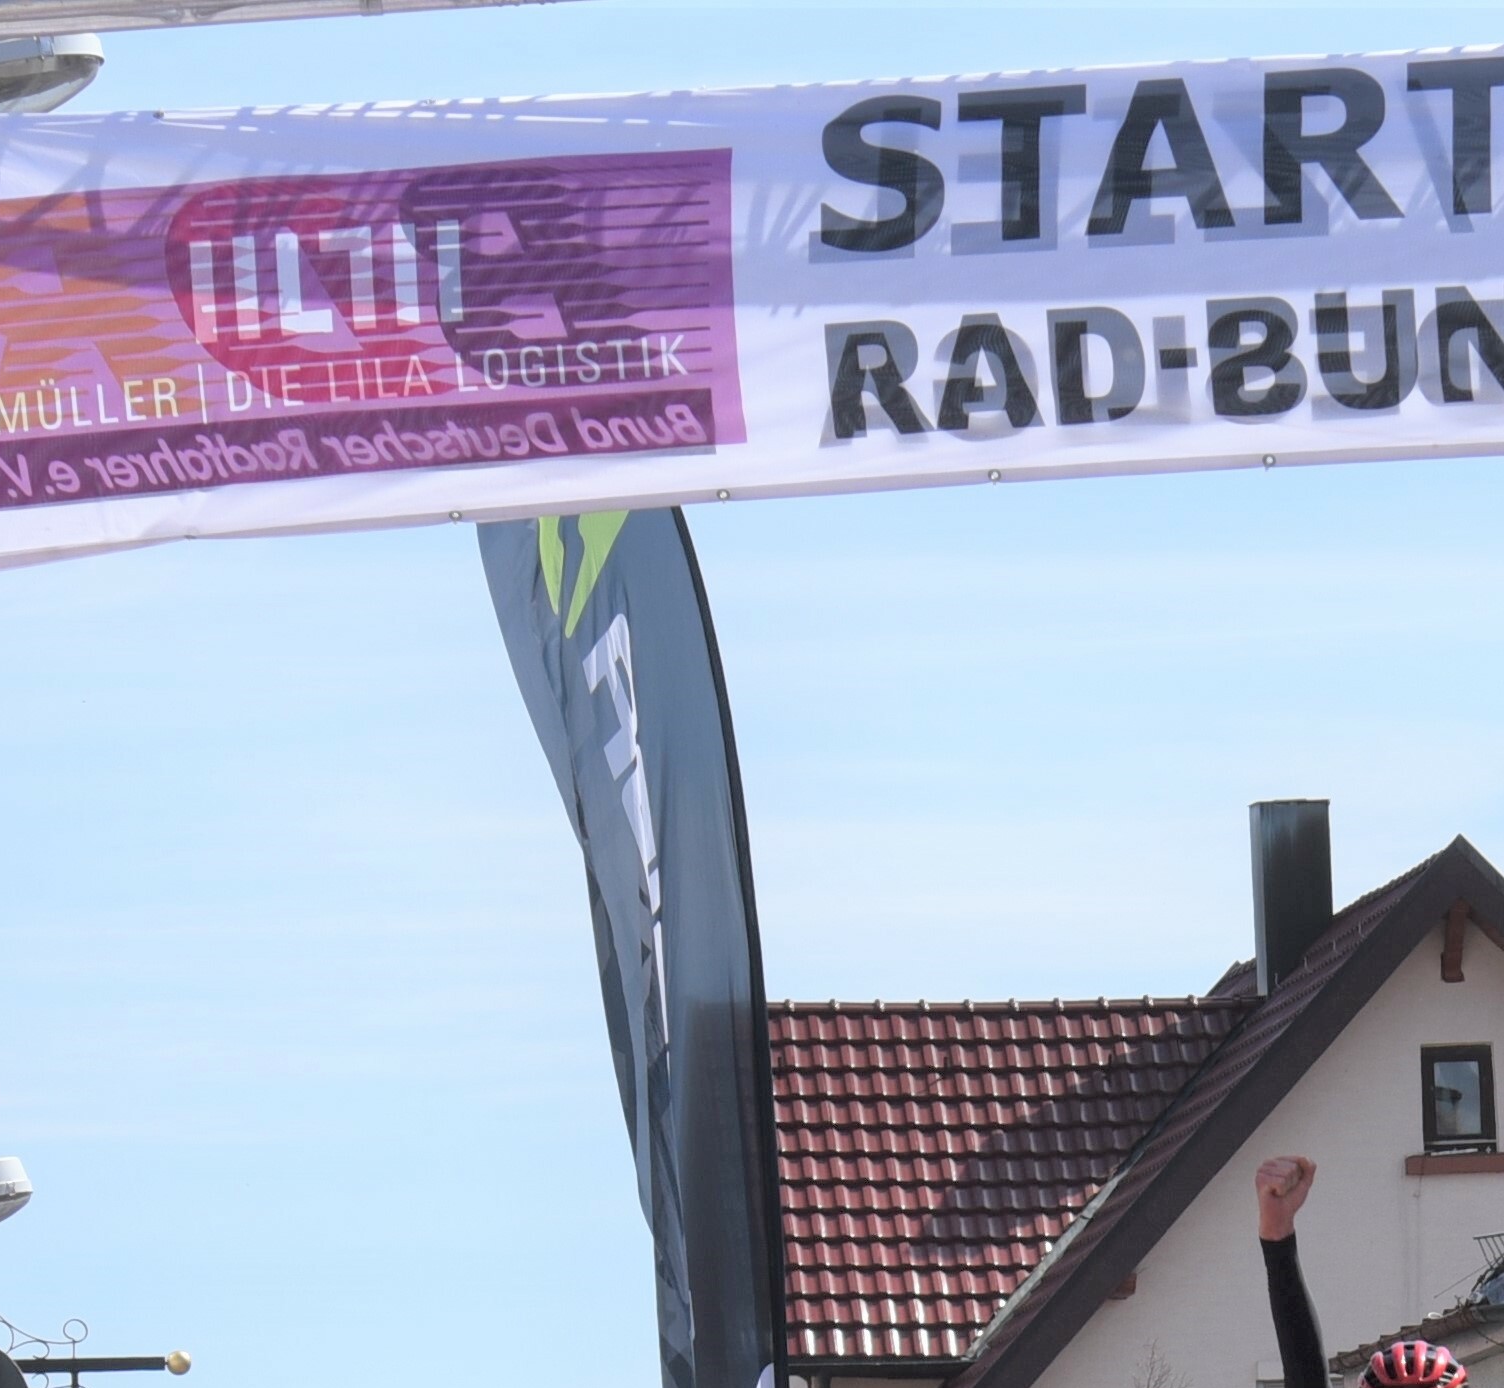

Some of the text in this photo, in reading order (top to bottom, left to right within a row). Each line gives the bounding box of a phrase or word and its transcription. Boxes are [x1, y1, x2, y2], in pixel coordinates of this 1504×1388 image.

[227, 366, 304, 413] DIE
[329, 354, 434, 403] LILA
[456, 333, 692, 393] LOGISTIK
